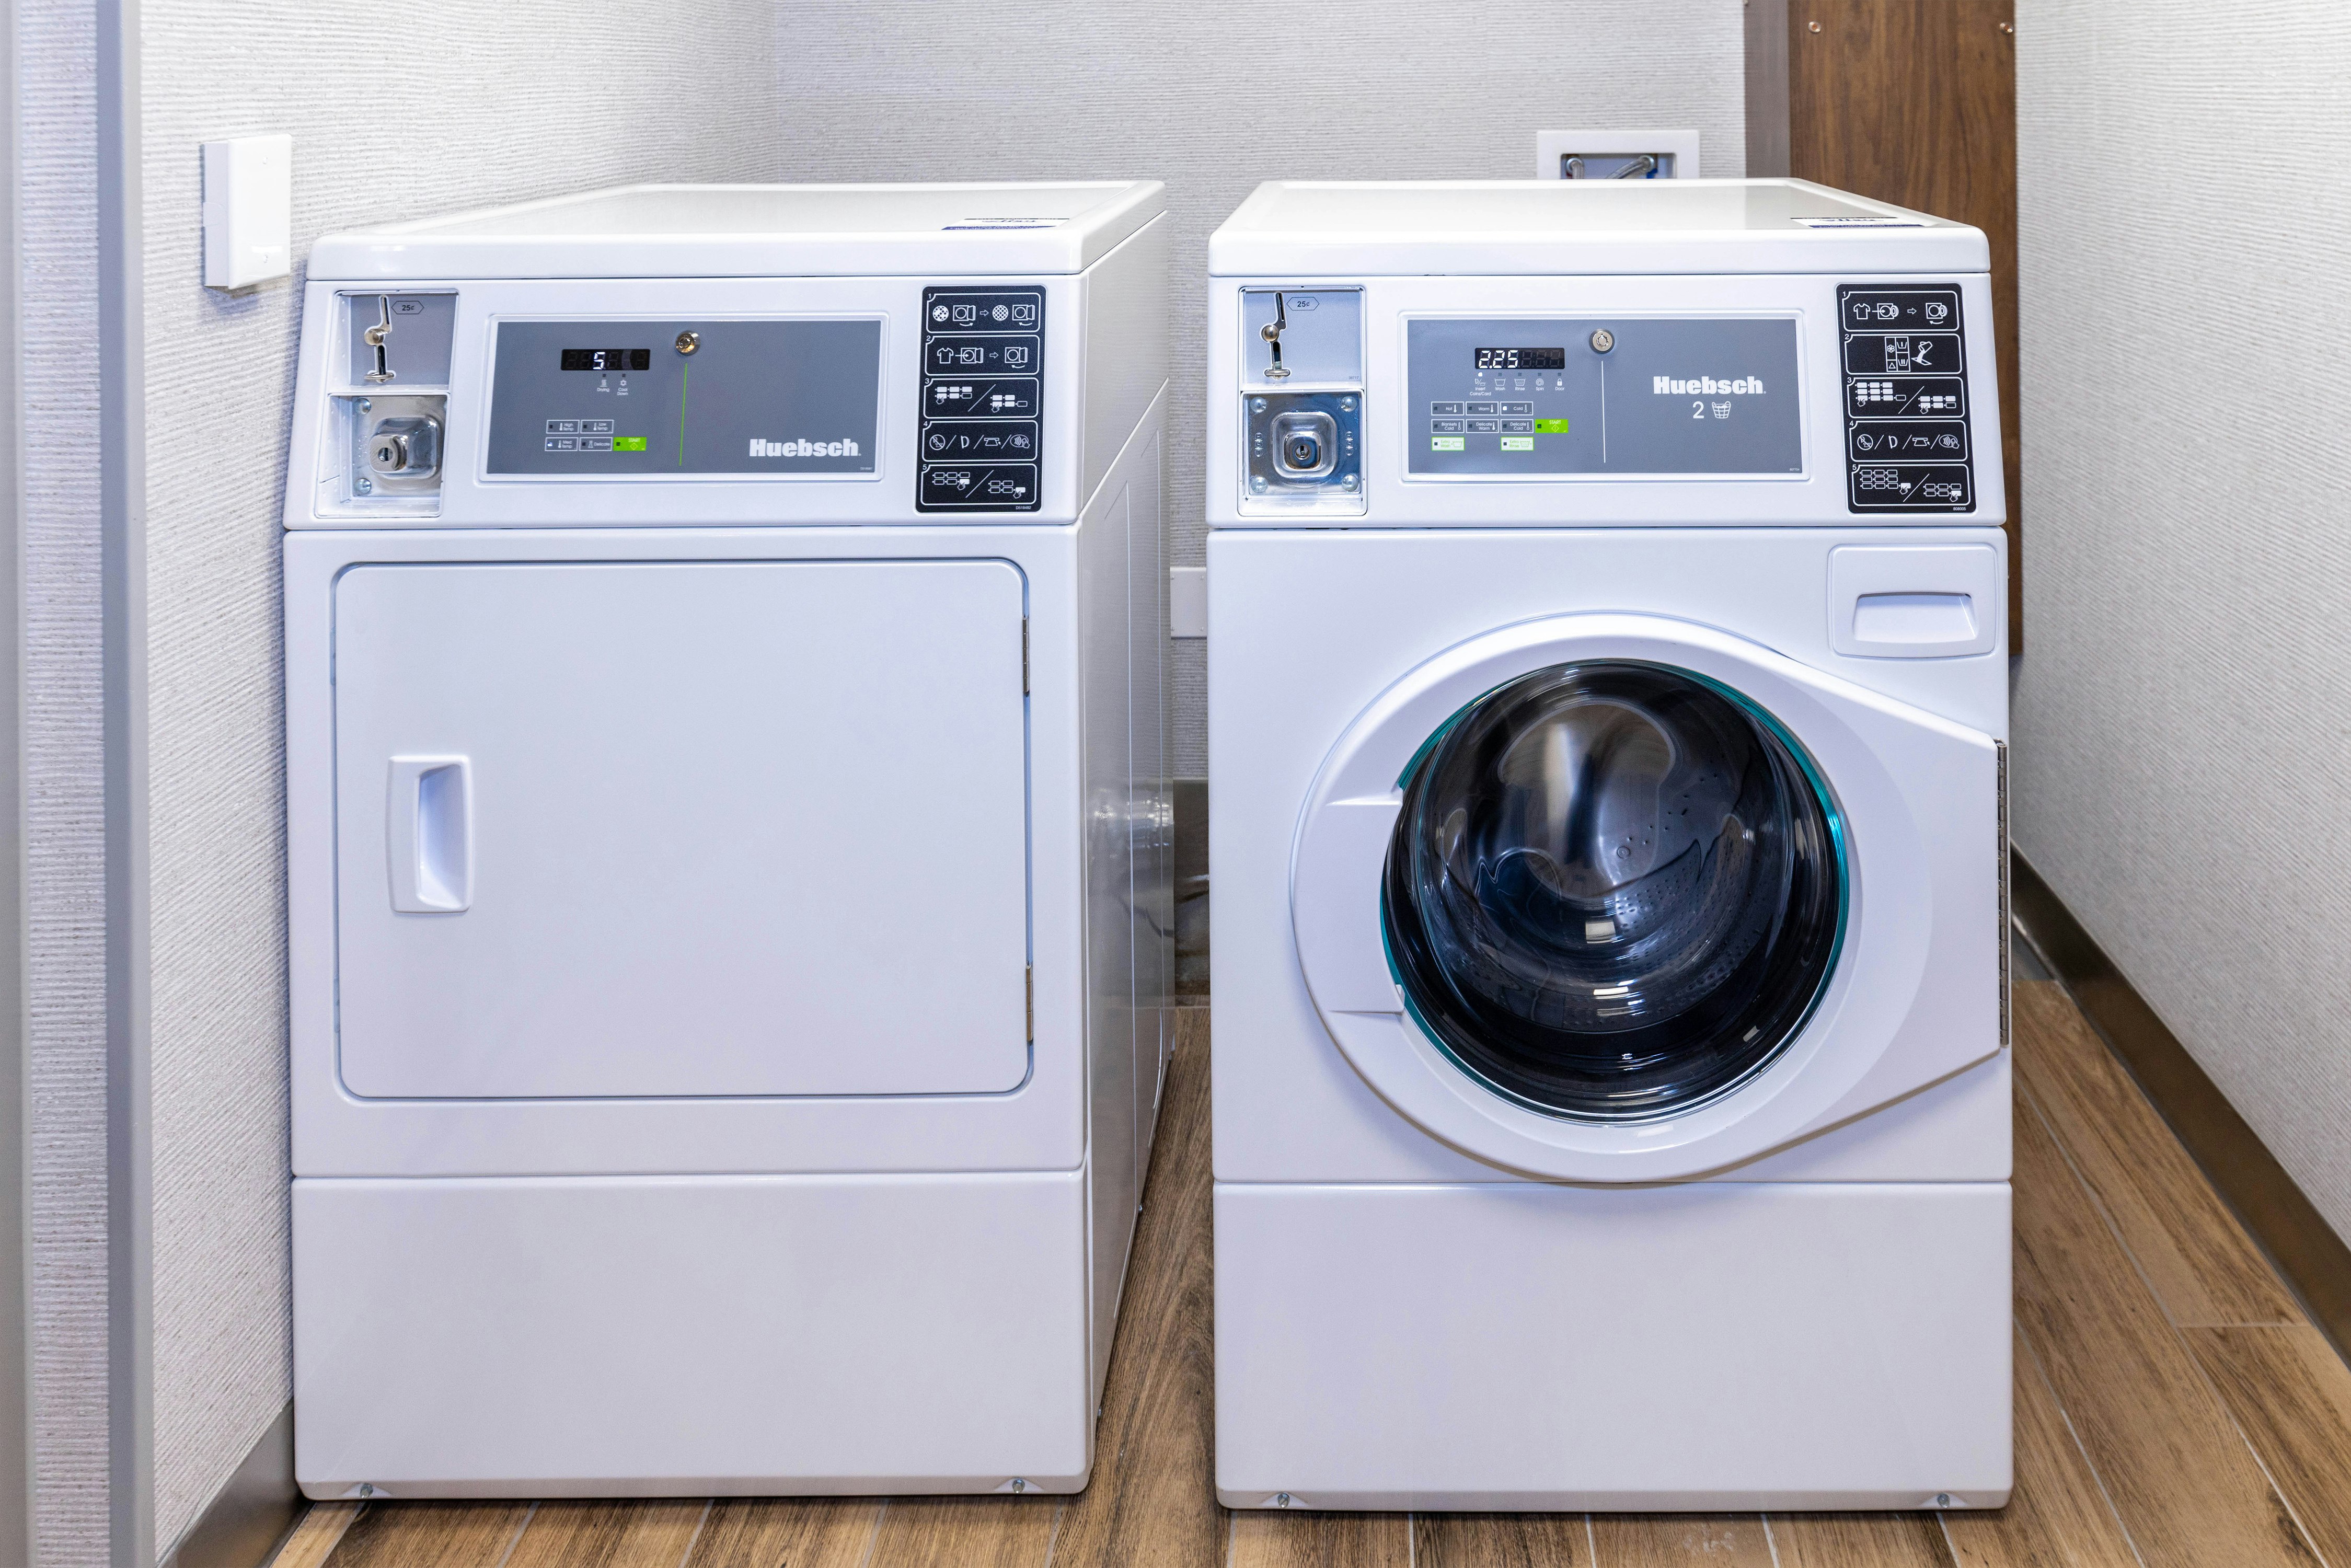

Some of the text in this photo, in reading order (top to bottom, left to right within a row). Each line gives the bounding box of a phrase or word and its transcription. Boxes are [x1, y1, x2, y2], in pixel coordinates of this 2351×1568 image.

[593, 352, 606, 370] 5
[1478, 350, 1519, 368] 2.25
[1653, 376, 1764, 395] Huebsch
[1692, 401, 1704, 419] 2
[749, 438, 859, 457] Huebsch
